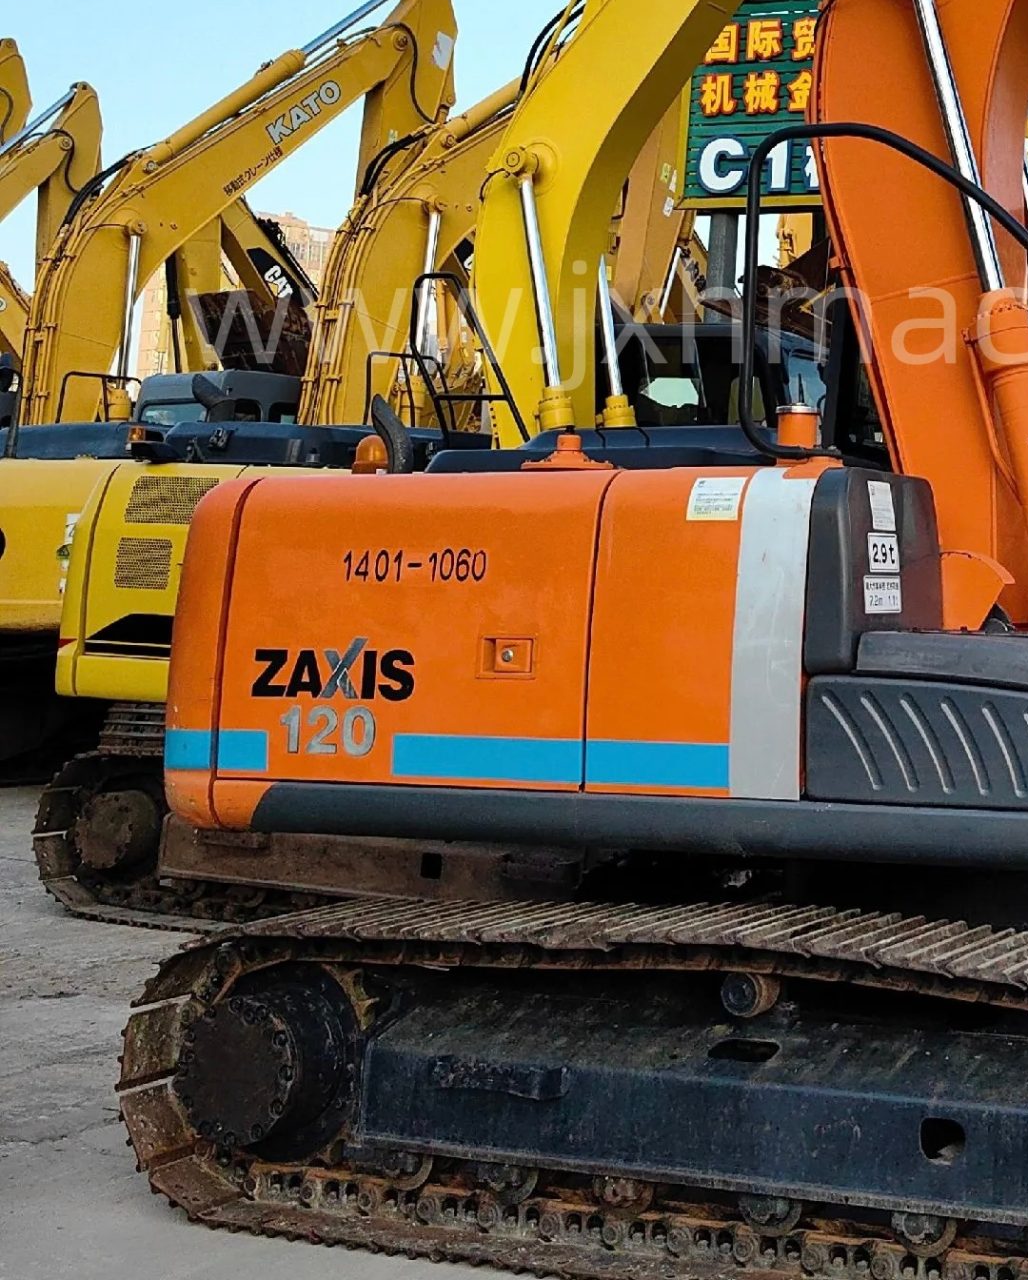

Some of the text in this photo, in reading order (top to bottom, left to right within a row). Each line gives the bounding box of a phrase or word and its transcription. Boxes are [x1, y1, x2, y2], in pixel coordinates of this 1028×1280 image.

[264, 79, 342, 146] KATO
[263, 264, 295, 300] CAT
[342, 548, 488, 583] 1401-1060
[250, 636, 416, 702] ZAXIS
[279, 705, 377, 758] 120
